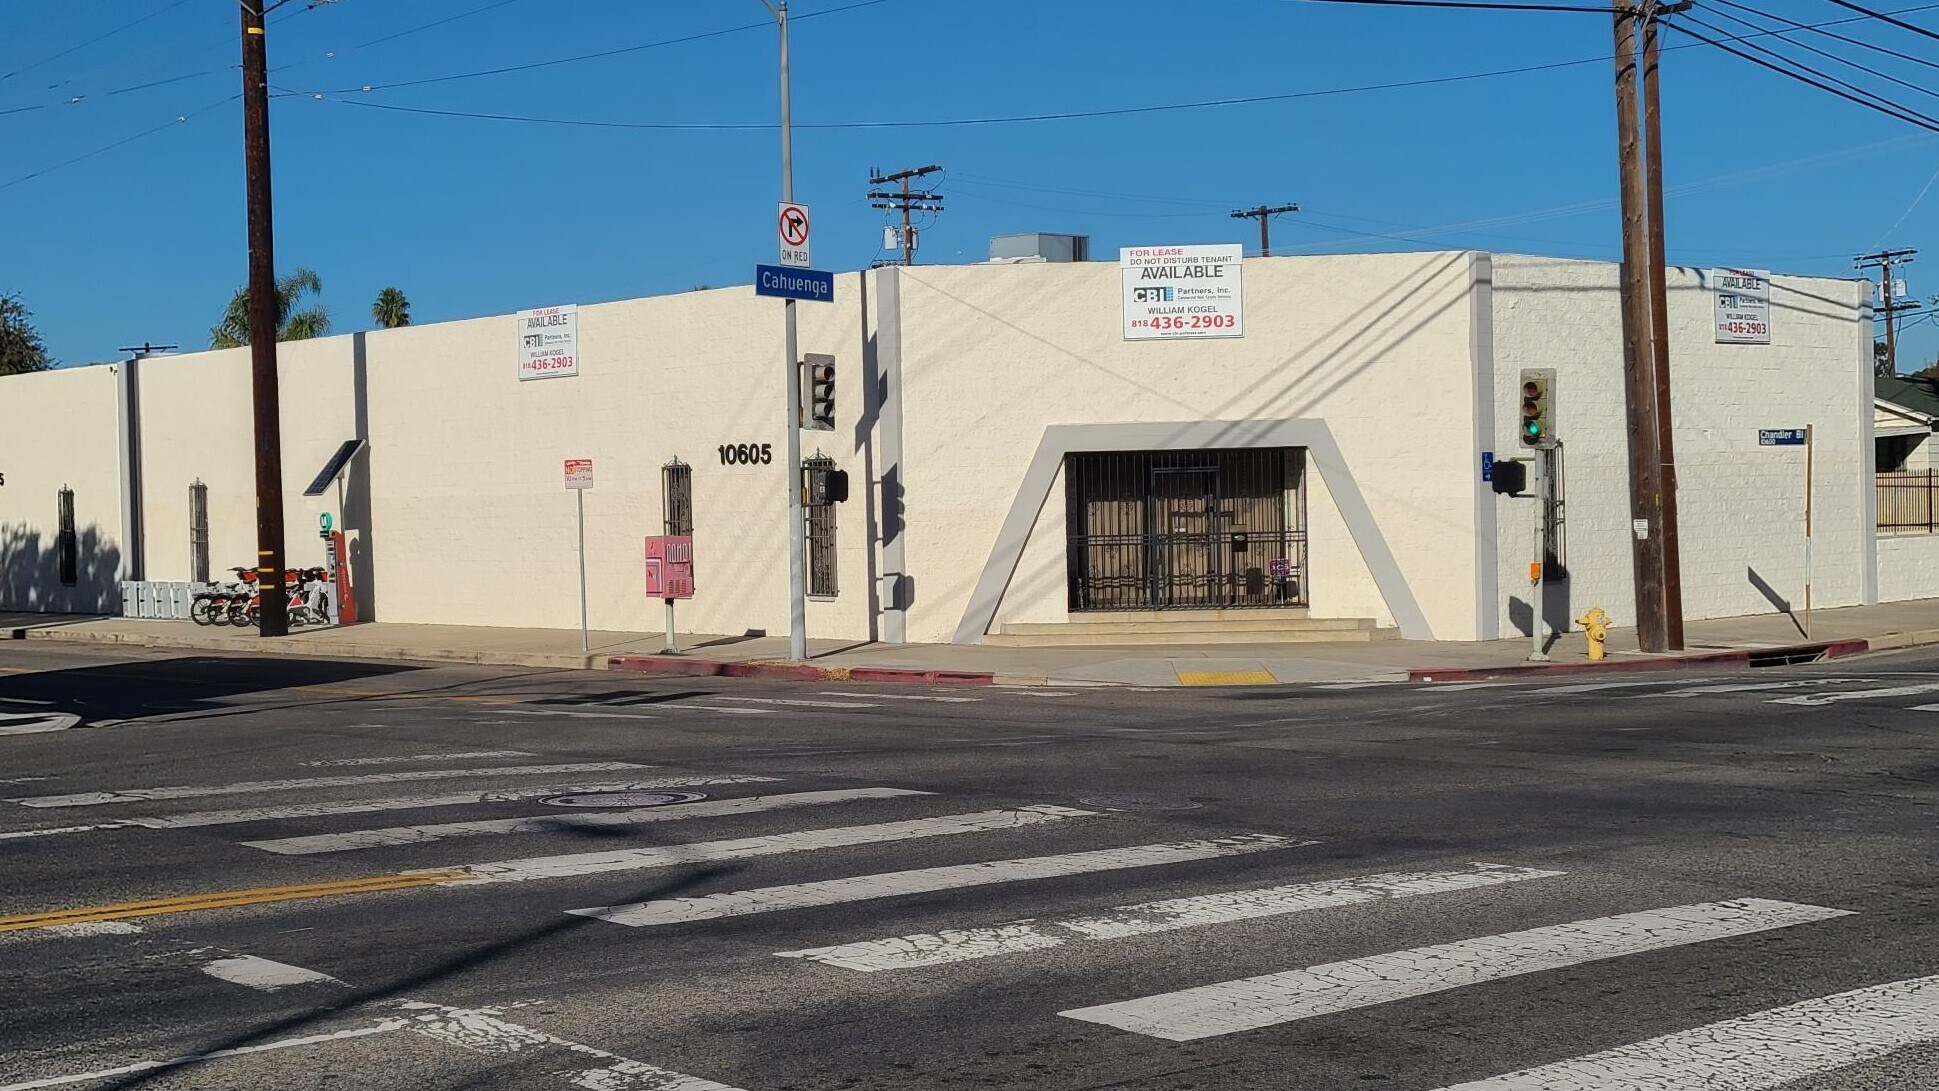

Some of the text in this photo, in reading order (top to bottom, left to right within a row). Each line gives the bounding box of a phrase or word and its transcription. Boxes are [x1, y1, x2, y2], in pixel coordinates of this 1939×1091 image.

[782, 249, 808, 262] ON RED
[1152, 248, 1184, 256] LEASE
[1163, 256, 1199, 264] DISTURB
[1140, 264, 1224, 280] AVAILABLE
[762, 271, 828, 298] Cahuenga
[1722, 276, 1761, 290] AVAILABLE
[1134, 286, 1165, 302] CBI
[1178, 288, 1214, 296] Partners,
[544, 308, 560, 316] LEASE
[1148, 306, 1218, 314] WILLIAM KOGEL
[527, 314, 568, 329] AVAILABLE
[1132, 314, 1235, 329] 818 436-2903
[1728, 322, 1766, 334] 436-2903
[524, 334, 539, 348] CBI
[532, 356, 573, 370] 436-2903
[1760, 430, 1792, 439] Chandler
[718, 443, 772, 466] 10605
[566, 466, 574, 474] NO
